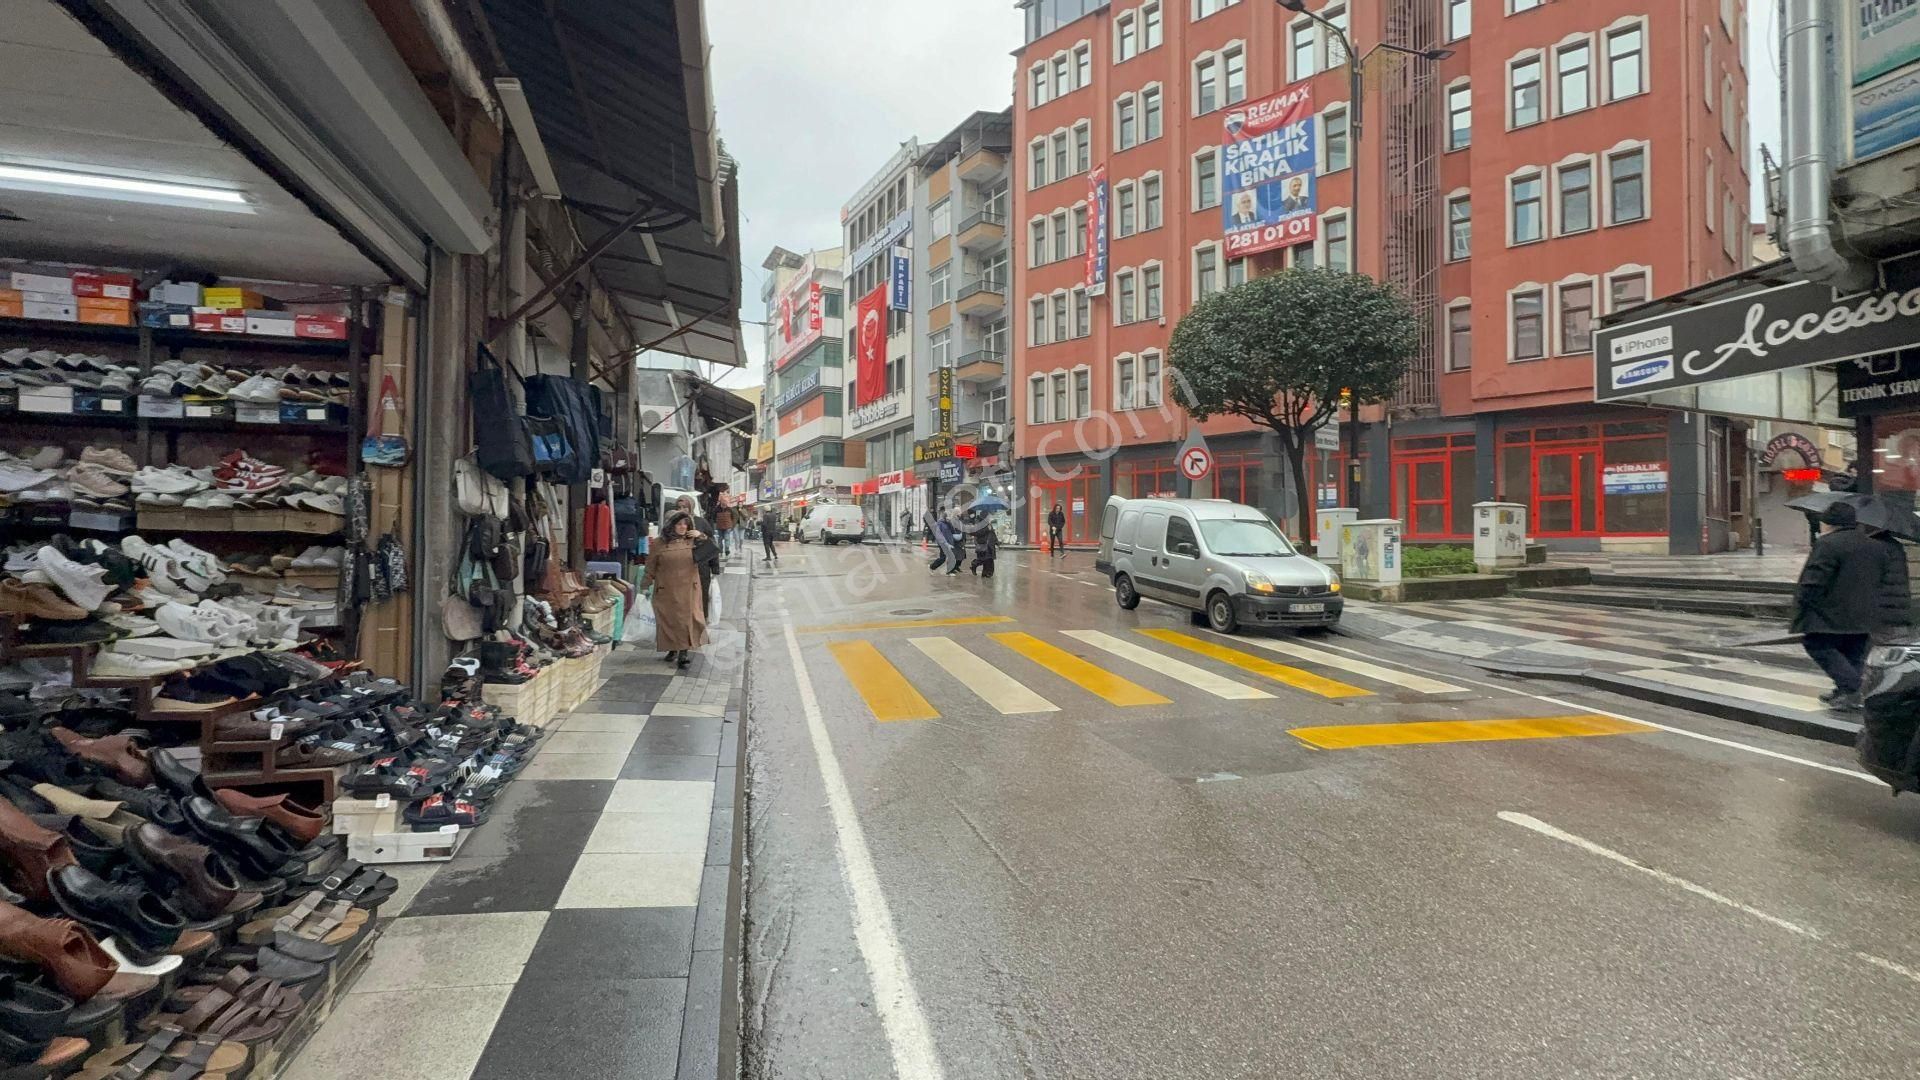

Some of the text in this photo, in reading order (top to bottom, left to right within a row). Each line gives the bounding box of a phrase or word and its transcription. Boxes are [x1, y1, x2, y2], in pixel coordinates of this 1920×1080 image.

[1248, 84, 1310, 119] RE/MAX
[1248, 110, 1283, 127] MEYDAN
[1226, 120, 1307, 159] SATILIK
[1225, 136, 1309, 176] KİRALIK
[1241, 159, 1292, 187] BİNA
[1087, 191, 1095, 284] SATILIK
[1230, 231, 1259, 250] 281
[1264, 224, 1285, 241] 01
[1289, 217, 1310, 234] 01
[898, 258, 905, 271] AK
[811, 291, 820, 319] CHP
[1625, 336, 1669, 352] iPhone
[1621, 365, 1665, 380] SAMSUNG
[1842, 383, 1887, 402] TEKNİK
[1763, 438, 1788, 464] HOTEL
[880, 473, 902, 486] ECZANE
[1616, 463, 1661, 473] KİRALIK
